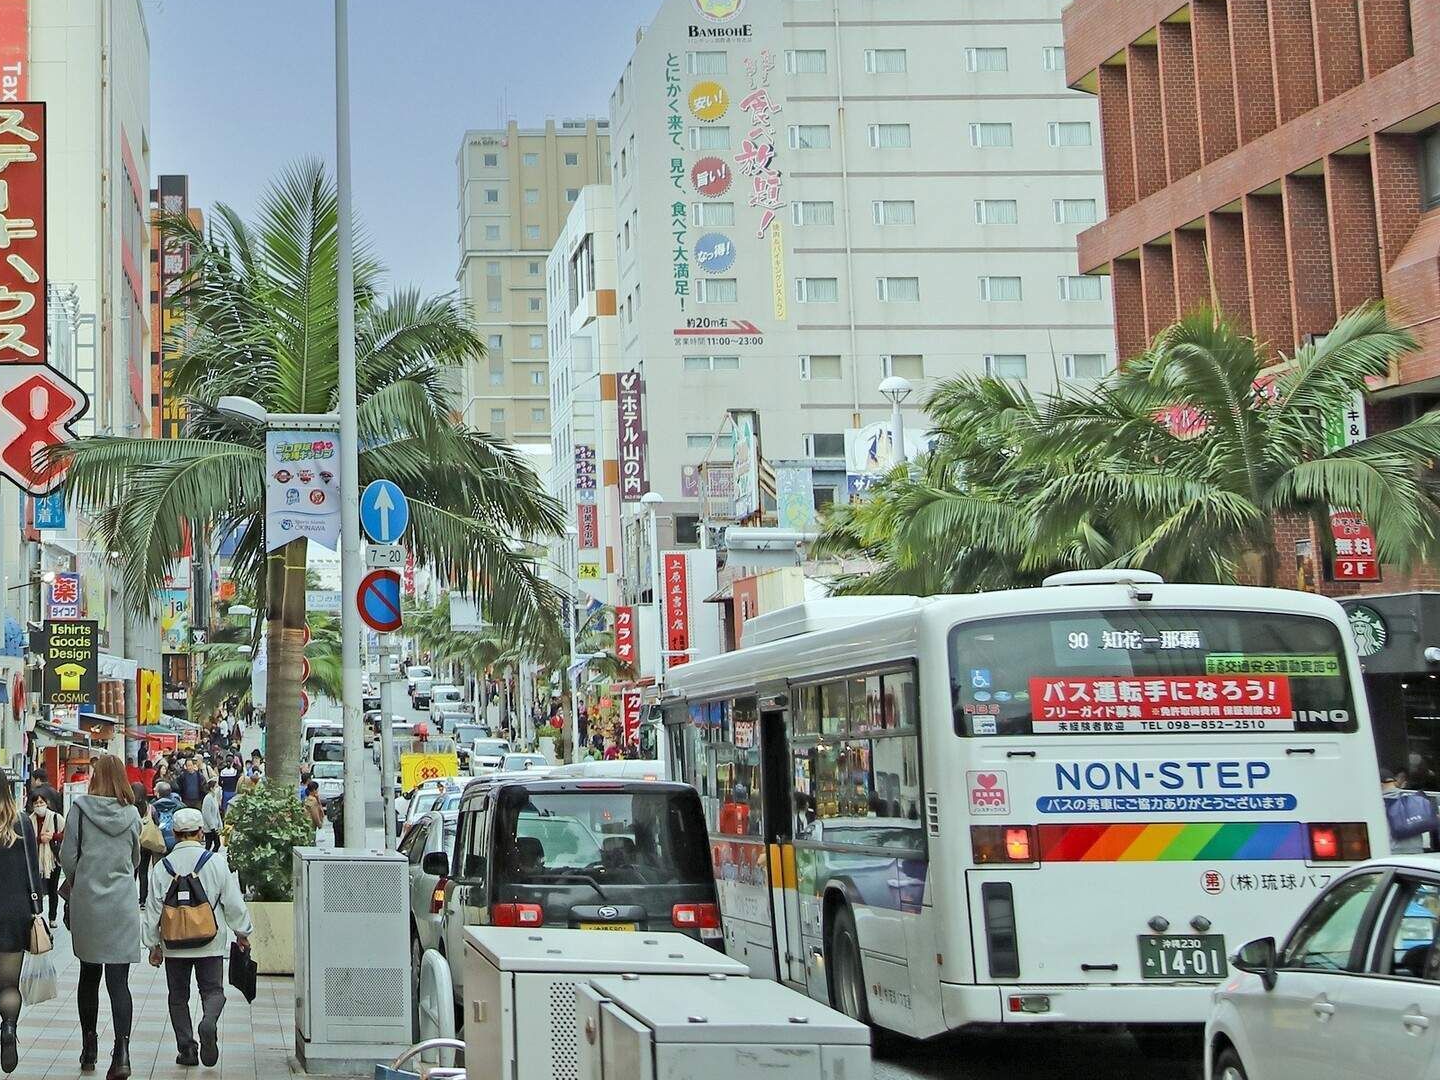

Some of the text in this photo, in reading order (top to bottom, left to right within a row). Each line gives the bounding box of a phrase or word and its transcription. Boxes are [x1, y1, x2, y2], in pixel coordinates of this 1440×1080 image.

[688, 24, 753, 38] BAMBOHE
[620, 396, 641, 494] ホテル山の内
[1334, 537, 1372, 556] 無料
[1342, 561, 1368, 576] 2F
[53, 577, 78, 603] 薬
[50, 623, 92, 635] Tshirts
[49, 635, 92, 647] Goods
[618, 612, 632, 666] カラオ
[1068, 632, 1089, 649] 90
[49, 648, 92, 661] Design
[51, 693, 90, 703] COSMIC
[1043, 680, 1277, 704] バス運転手になろう!
[1043, 706, 1142, 718] フリーガイド募集
[1292, 709, 1349, 723] INO
[1141, 721, 1163, 730] TEL
[1056, 762, 1272, 791] NON-STEP
[1046, 796, 1288, 812] バスの発車にご協力ありがとうございます
[1159, 950, 1222, 976] 14-01
